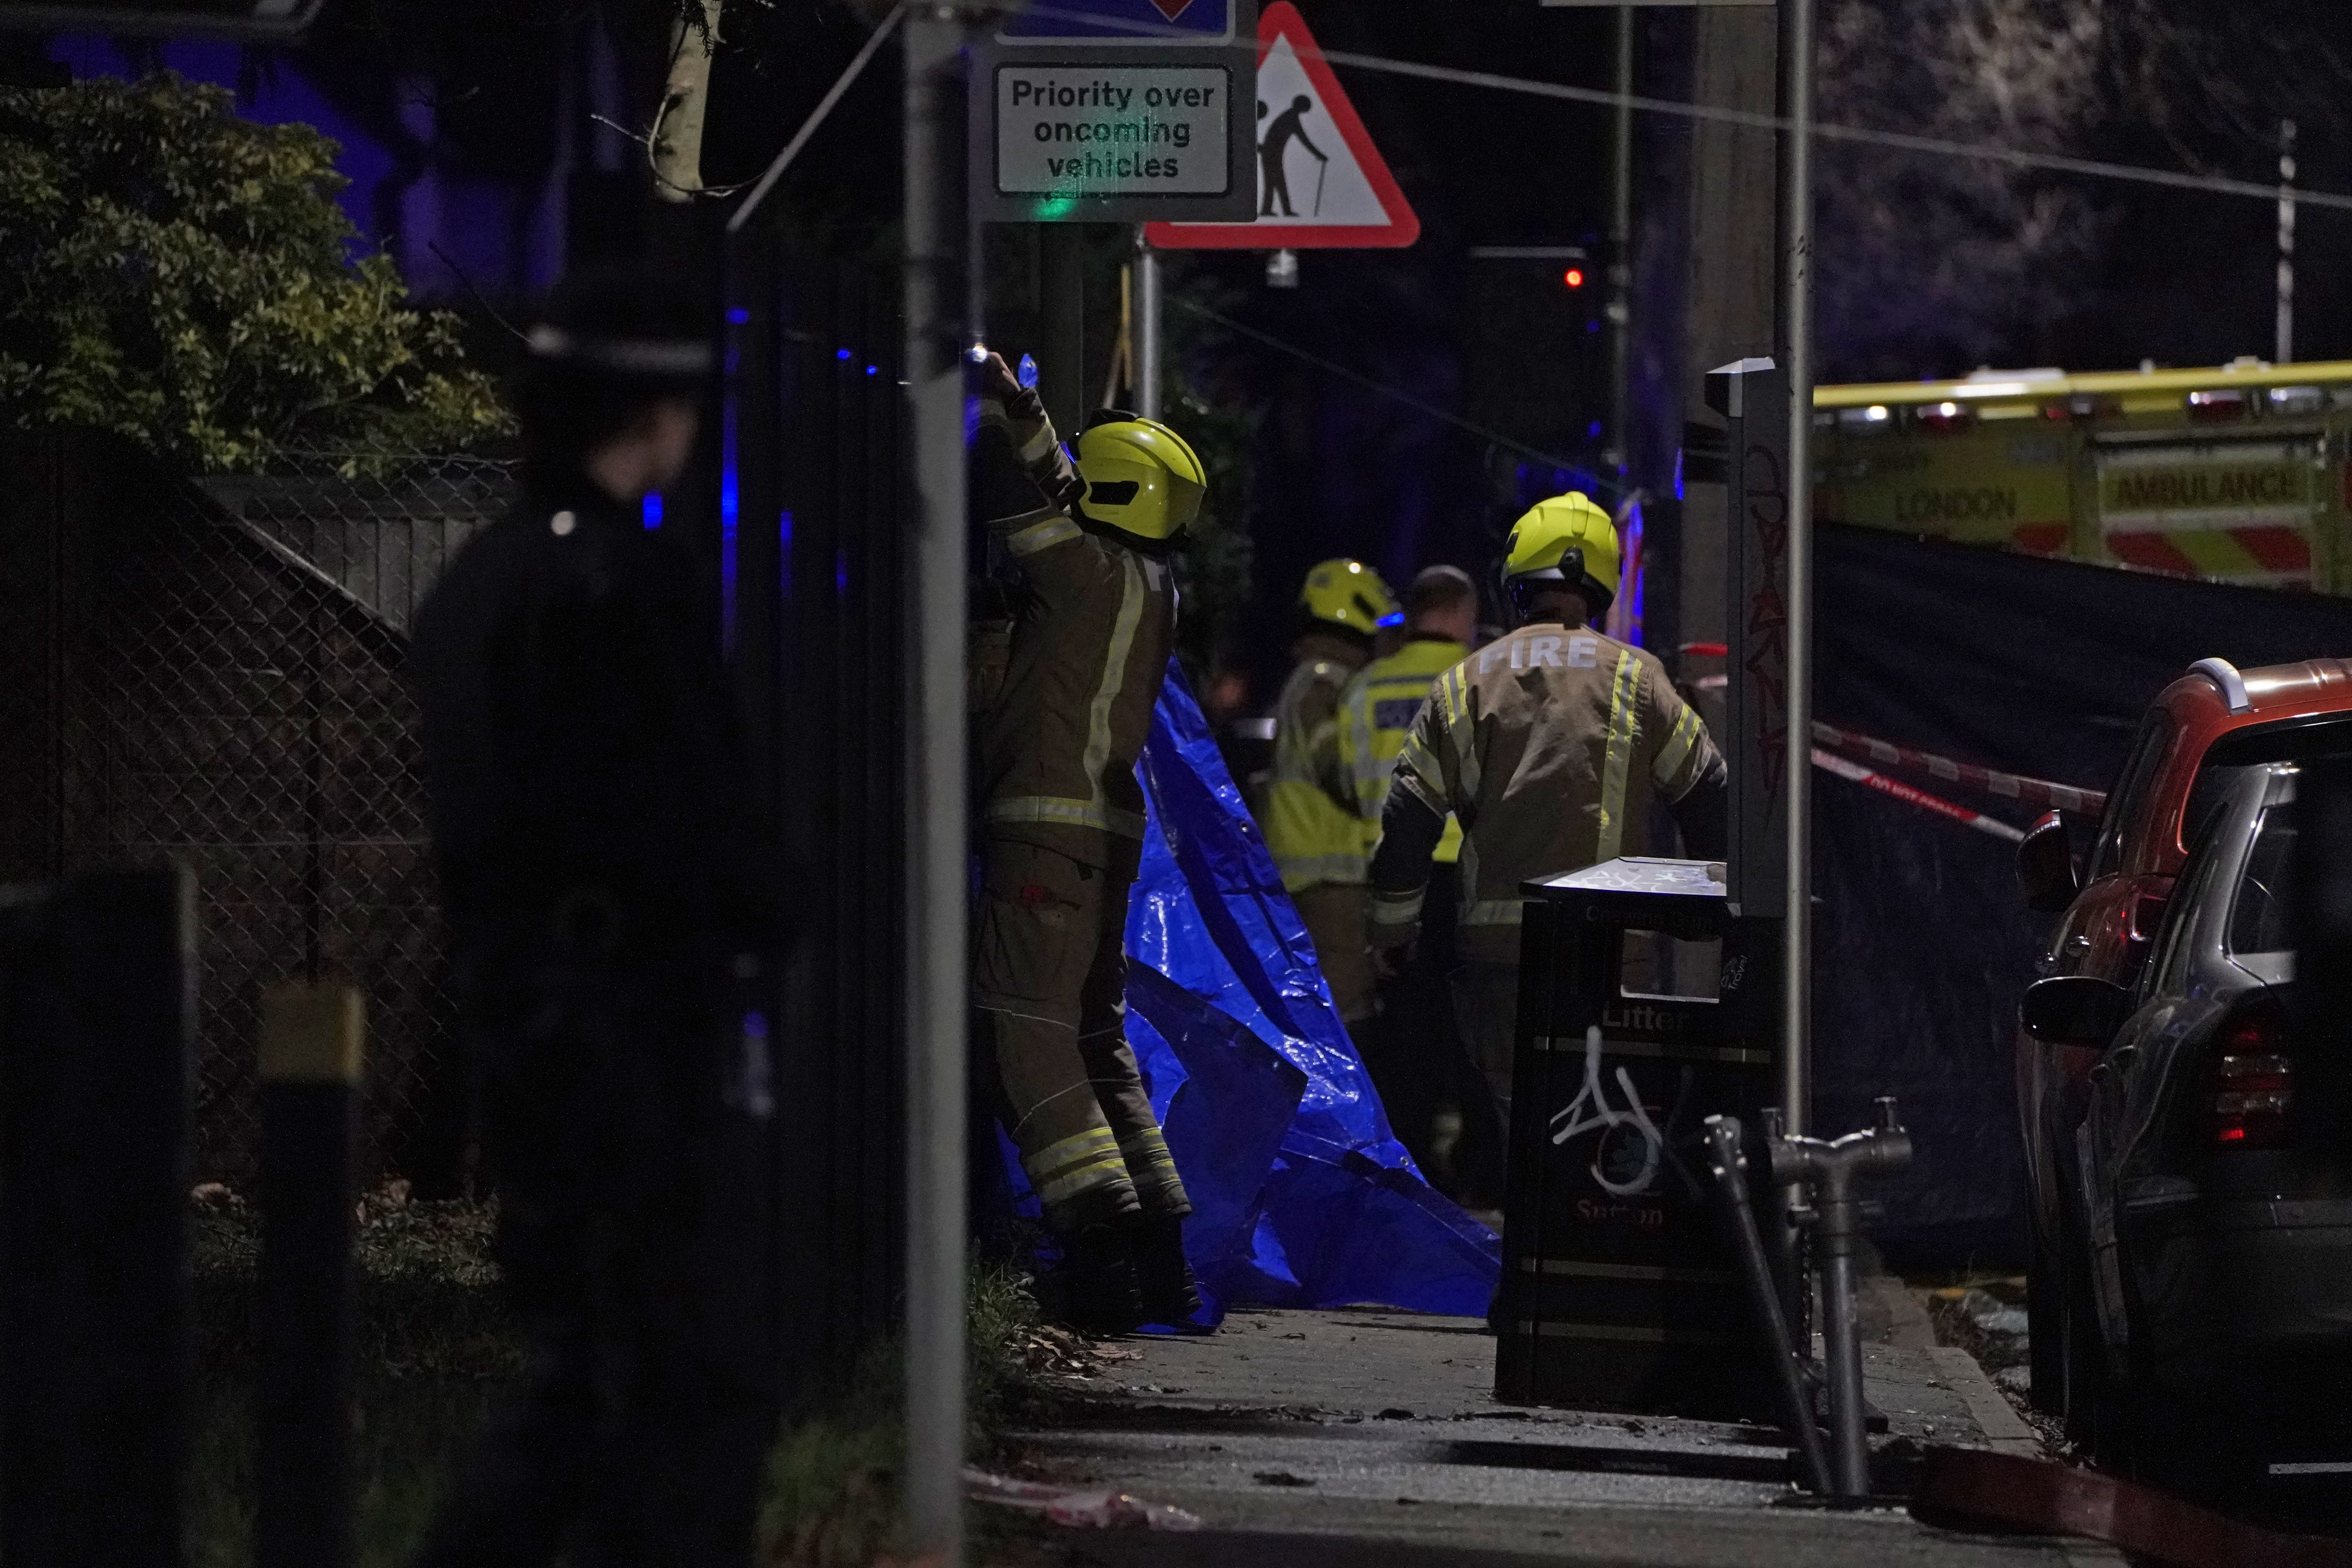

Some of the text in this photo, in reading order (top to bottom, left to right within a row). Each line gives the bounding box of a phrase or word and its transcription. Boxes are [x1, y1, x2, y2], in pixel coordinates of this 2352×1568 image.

[1012, 79, 1215, 112] Priority over
[1034, 116, 1191, 148] oncoming
[1046, 151, 1179, 178] vehicles
[1895, 486, 2016, 521] LONDON
[2117, 468, 2296, 507] AMBULANCE
[1479, 636, 1598, 674] FIRE
[1602, 1001, 1687, 1031] Litter
